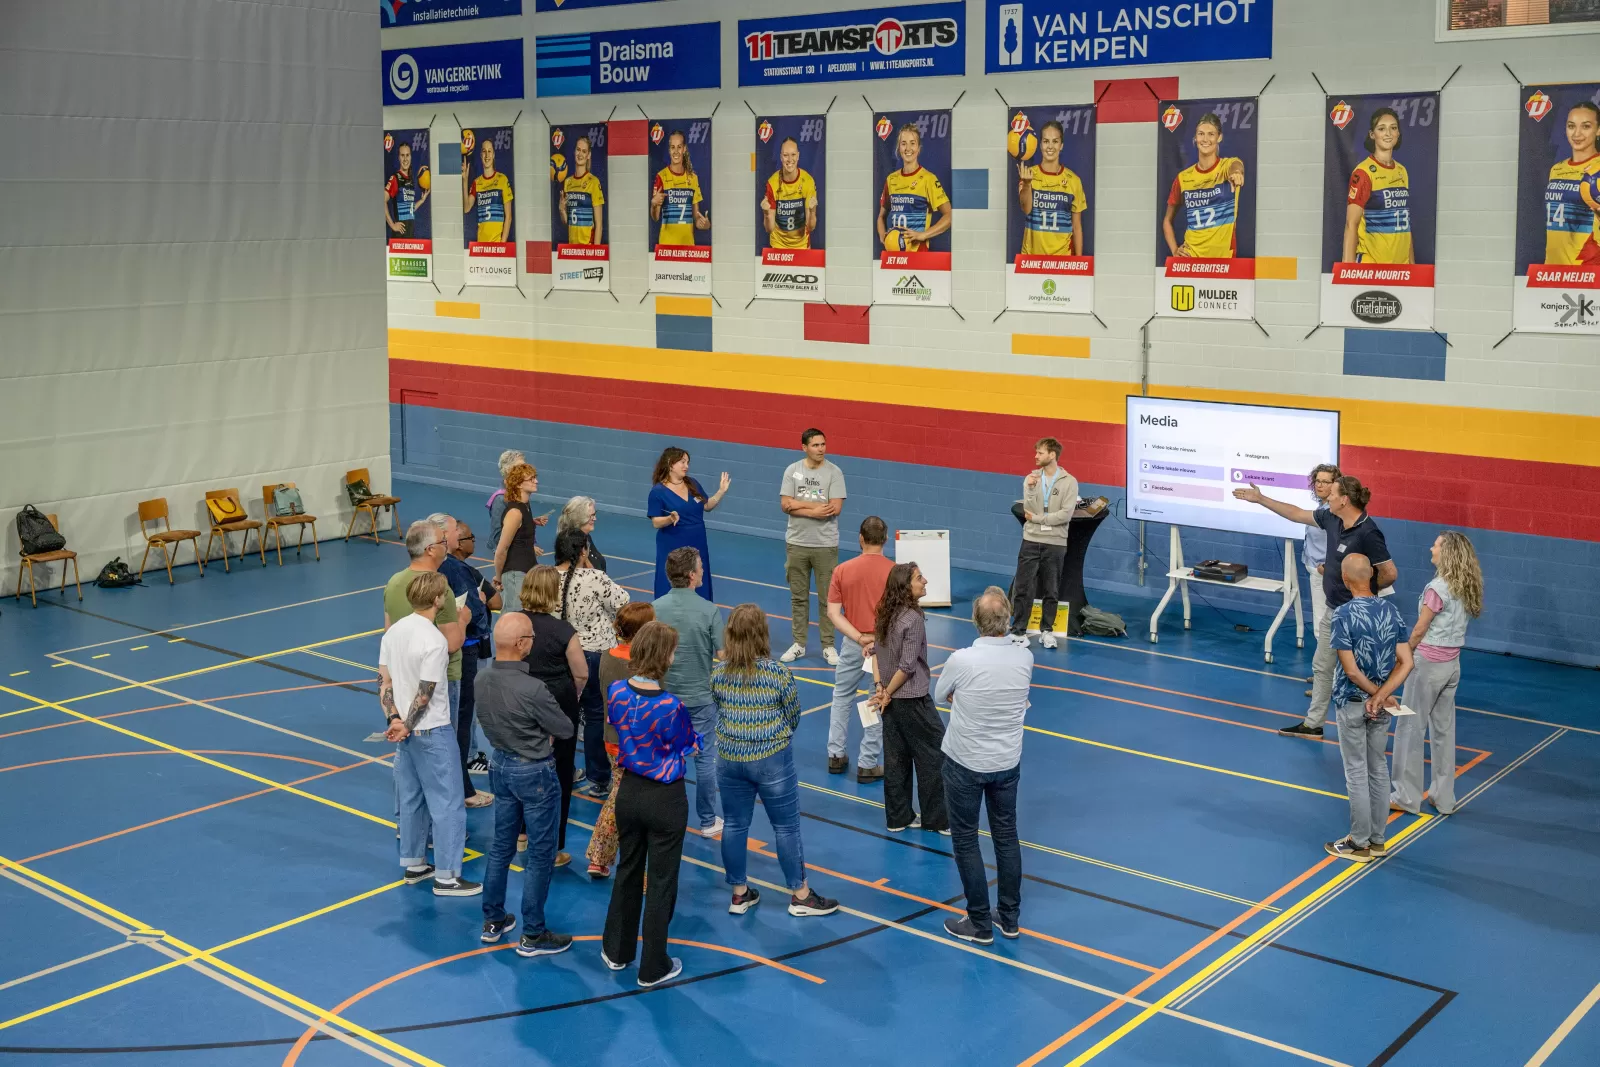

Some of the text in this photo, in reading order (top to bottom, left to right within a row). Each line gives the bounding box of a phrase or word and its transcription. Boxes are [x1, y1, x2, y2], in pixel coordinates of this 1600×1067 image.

[412, 4, 480, 22] installatietechniek
[1032, 0, 1252, 37] VAN LANSCHOT
[600, 40, 674, 62] Draisma
[1034, 34, 1148, 64] KEMPEN
[764, 65, 815, 76] STATIONSSTRAAT 130
[828, 62, 856, 72] APELDOORN
[870, 58, 934, 70] WWW.11TEAMSPORTS.NL
[425, 63, 502, 84] VAN GERREVINK
[600, 66, 650, 84] Bouw
[1056, 109, 1092, 135] #11
[1212, 102, 1254, 129] #12
[688, 122, 710, 144] #7
[800, 119, 824, 142] #8
[916, 114, 949, 138] #10
[494, 130, 512, 150] #5
[1547, 181, 1580, 192] raisma
[1034, 191, 1068, 202] Draisma
[1384, 198, 1406, 208] Bouw
[1545, 192, 1563, 200] ouw
[1033, 199, 1057, 209] Bouw
[485, 206, 492, 220] 5
[571, 208, 578, 224] 6
[678, 204, 687, 220] 7
[1192, 208, 1216, 229] 12
[1546, 202, 1565, 227] 14
[787, 216, 795, 230] 8
[1039, 211, 1059, 231] 11
[1394, 209, 1409, 231] 13
[886, 256, 896, 264] JET
[1021, 260, 1041, 269] SANNE
[1172, 263, 1230, 273] SUUS GERRITSEN
[1340, 269, 1411, 280] DAGMAR MOURITS
[655, 273, 706, 282] jaarverslag.org
[782, 274, 818, 284] ACD
[1536, 271, 1596, 283] SAAR MEIJER
[1198, 290, 1238, 300] MULDER
[1198, 301, 1238, 310] CONNECT
[1541, 302, 1570, 312] Kanjers
[1140, 414, 1178, 428] Media
